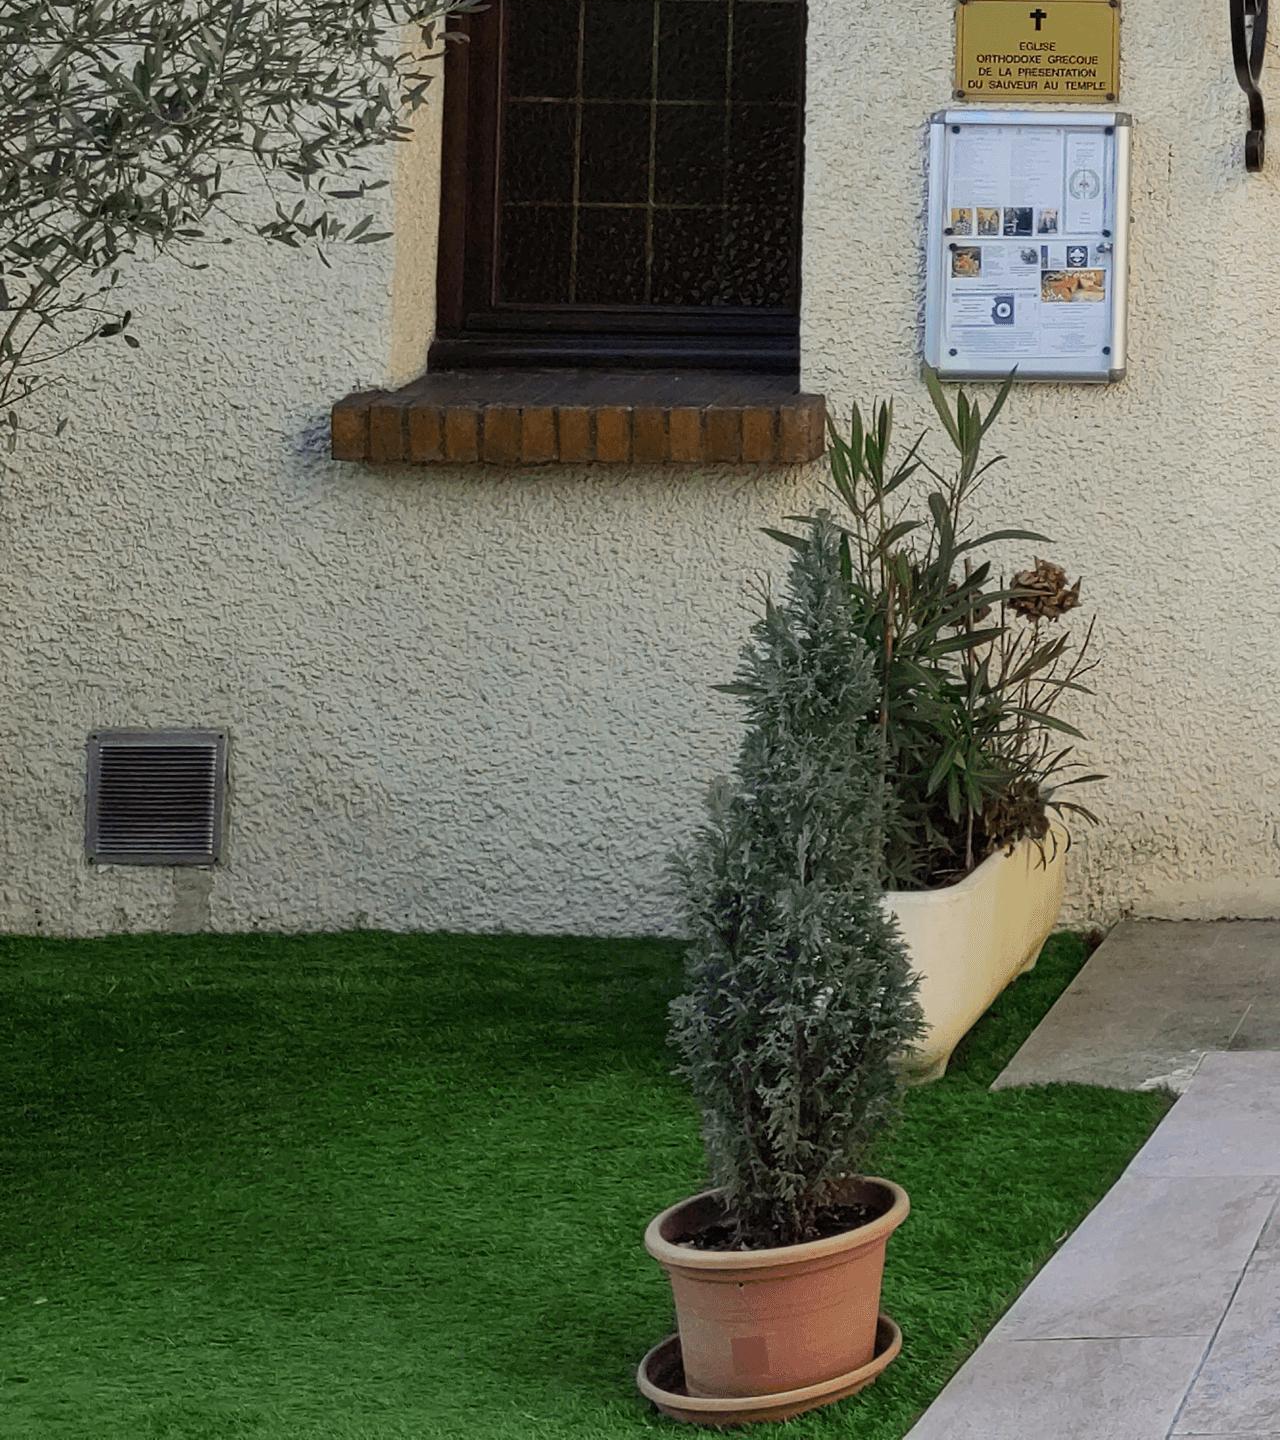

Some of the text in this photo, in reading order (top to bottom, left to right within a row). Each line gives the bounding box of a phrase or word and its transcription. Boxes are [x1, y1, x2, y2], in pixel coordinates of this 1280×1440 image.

[1019, 42, 1056, 51] EGLISE
[976, 54, 1042, 64] ORTHODOXE
[978, 67, 1096, 77] DE LA PRESENTATION
[967, 80, 1107, 90] DU SAUVEUR AU TEMPLE
